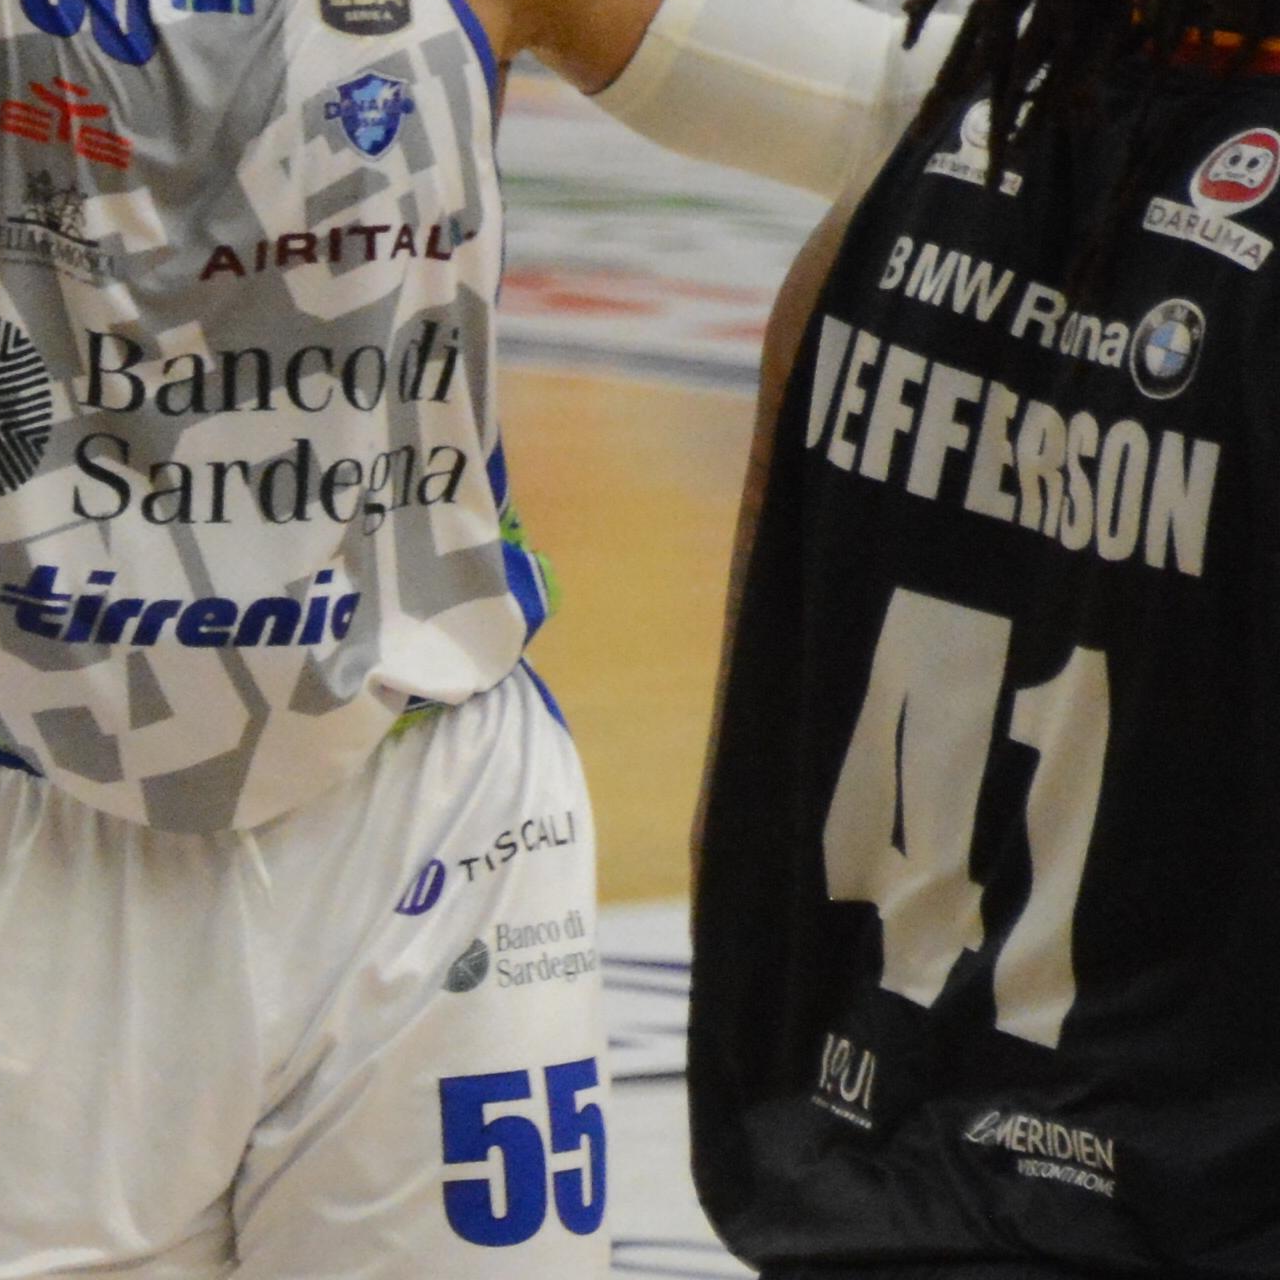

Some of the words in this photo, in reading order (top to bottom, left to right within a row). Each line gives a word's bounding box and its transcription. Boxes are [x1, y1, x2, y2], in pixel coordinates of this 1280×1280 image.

[879, 235, 1014, 322] BMW
[1147, 204, 1262, 264] DARUMA
[78, 328, 388, 418] Banco
[398, 320, 461, 404] di
[72, 431, 467, 535] Sardegna
[806, 312, 1222, 577] JEFFERSON
[458, 811, 575, 881] TISCALI
[822, 586, 1111, 1051] 41
[496, 920, 560, 952] Banco
[563, 910, 585, 939] di
[496, 948, 596, 988] Sardegna
[440, 1056, 607, 1248] 55
